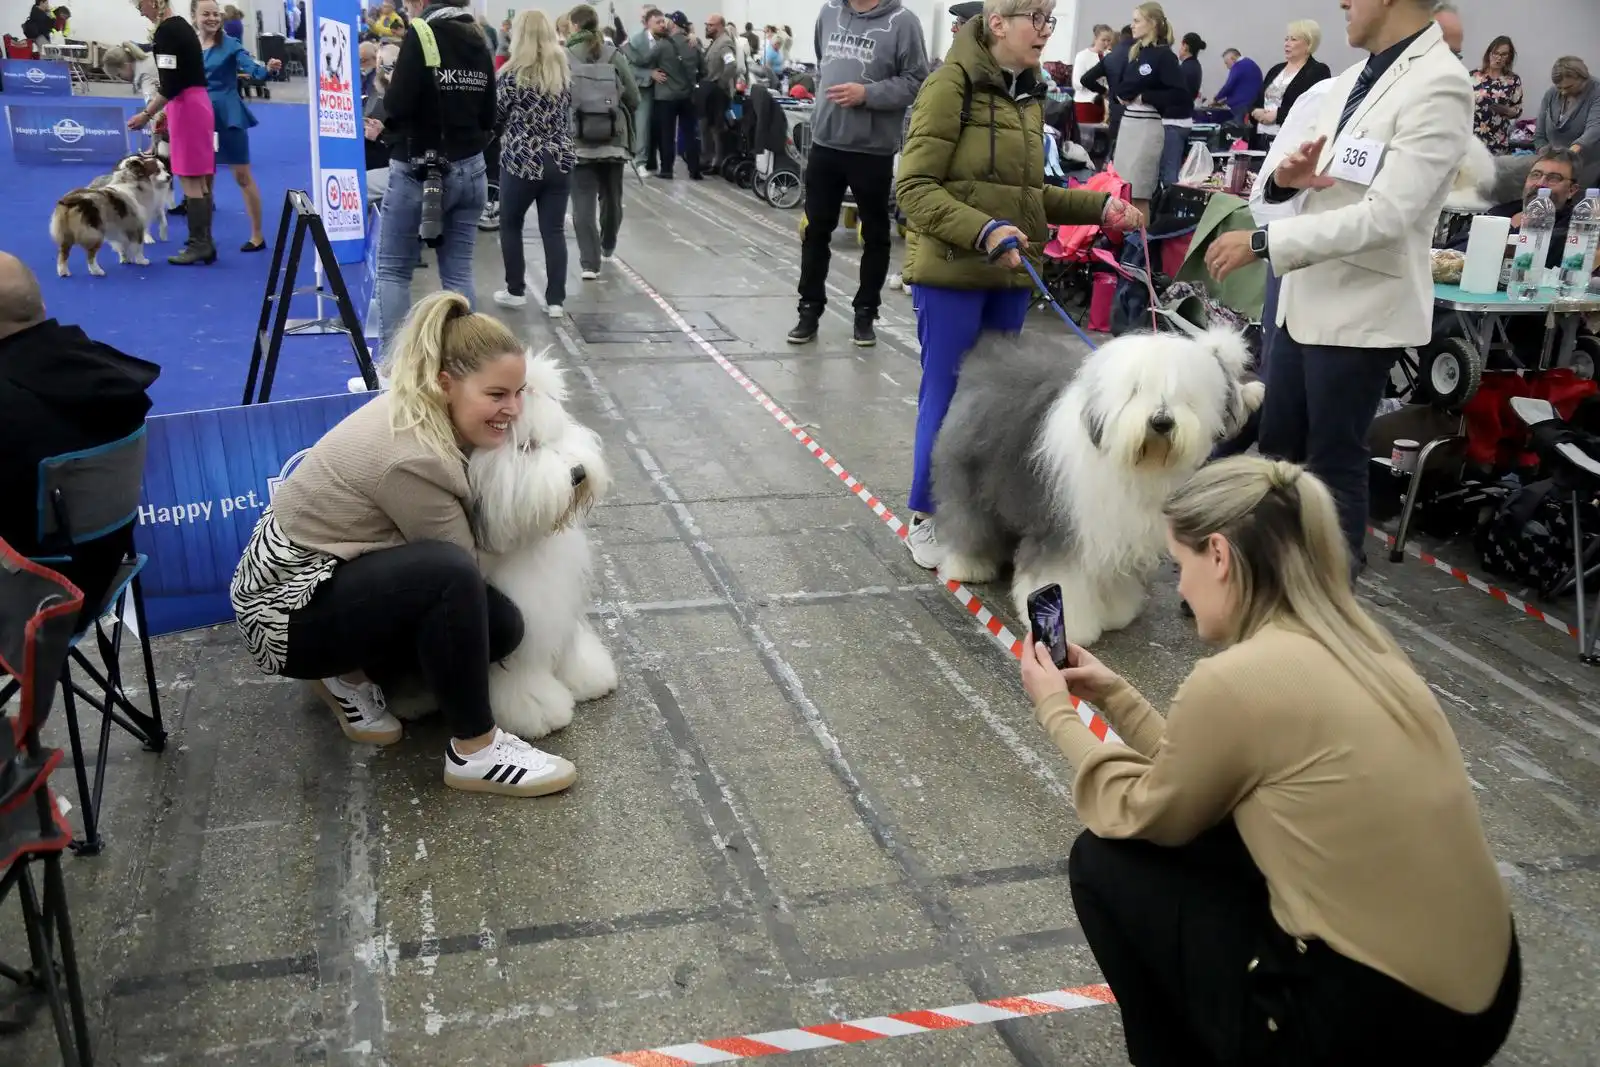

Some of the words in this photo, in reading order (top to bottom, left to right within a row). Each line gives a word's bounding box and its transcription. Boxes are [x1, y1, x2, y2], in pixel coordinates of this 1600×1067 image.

[319, 93, 353, 112] WORLD
[319, 110, 335, 120] DOG
[335, 111, 354, 122] SHOW
[1342, 147, 1368, 168] 336
[341, 191, 360, 211] DOG
[138, 501, 213, 526] Happy
[220, 489, 264, 518] pet.
